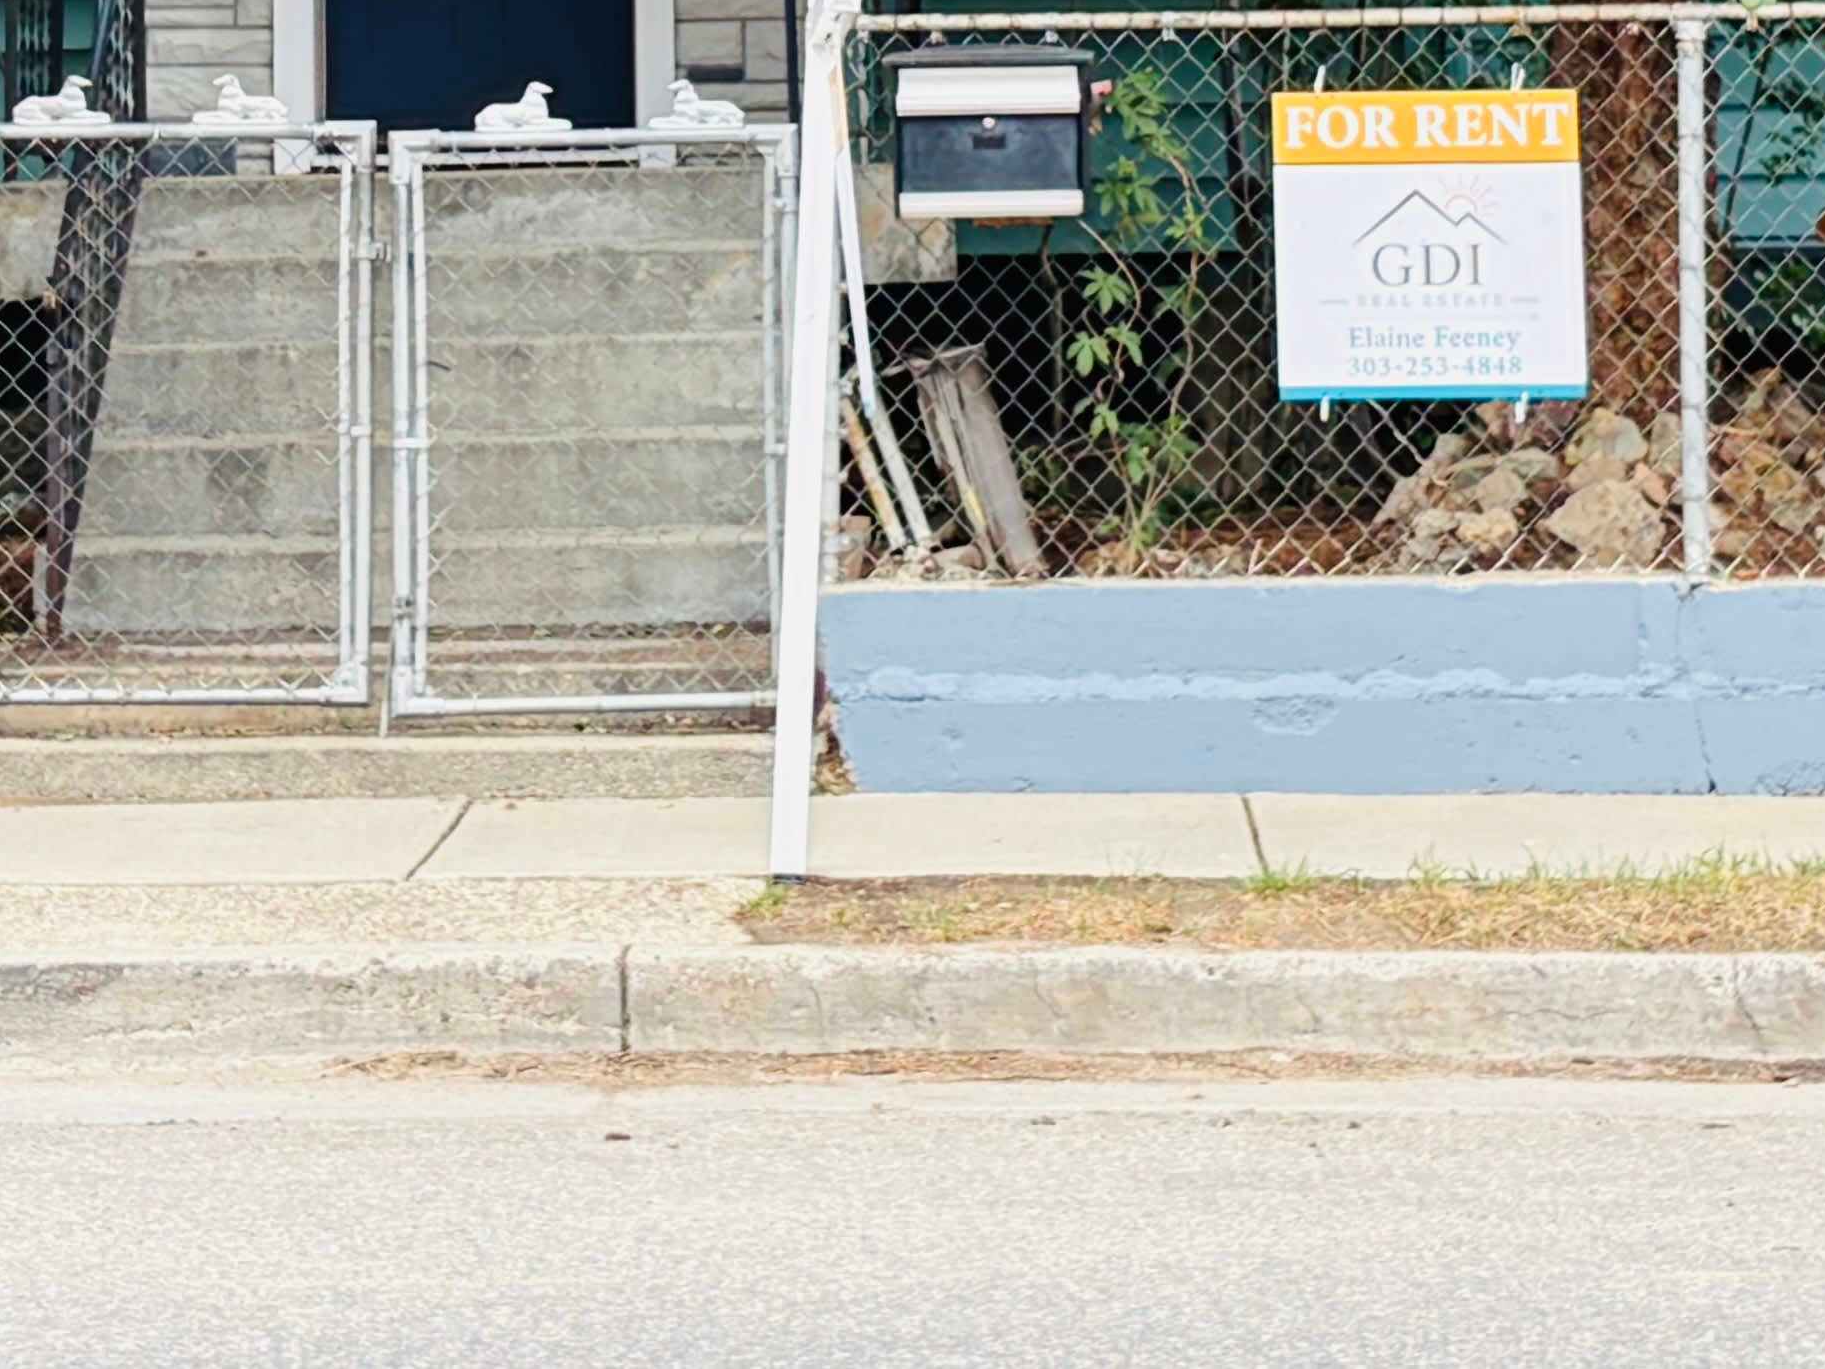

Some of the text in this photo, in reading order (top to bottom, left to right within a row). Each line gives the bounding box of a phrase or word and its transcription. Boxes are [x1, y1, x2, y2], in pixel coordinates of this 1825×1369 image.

[1285, 103, 1570, 150] FOR RENT
[1371, 243, 1485, 287] GDI
[1356, 292, 1412, 308] REAL
[1348, 324, 1523, 352] Elaine Feeney
[1347, 355, 1523, 377] 303-253-4848
